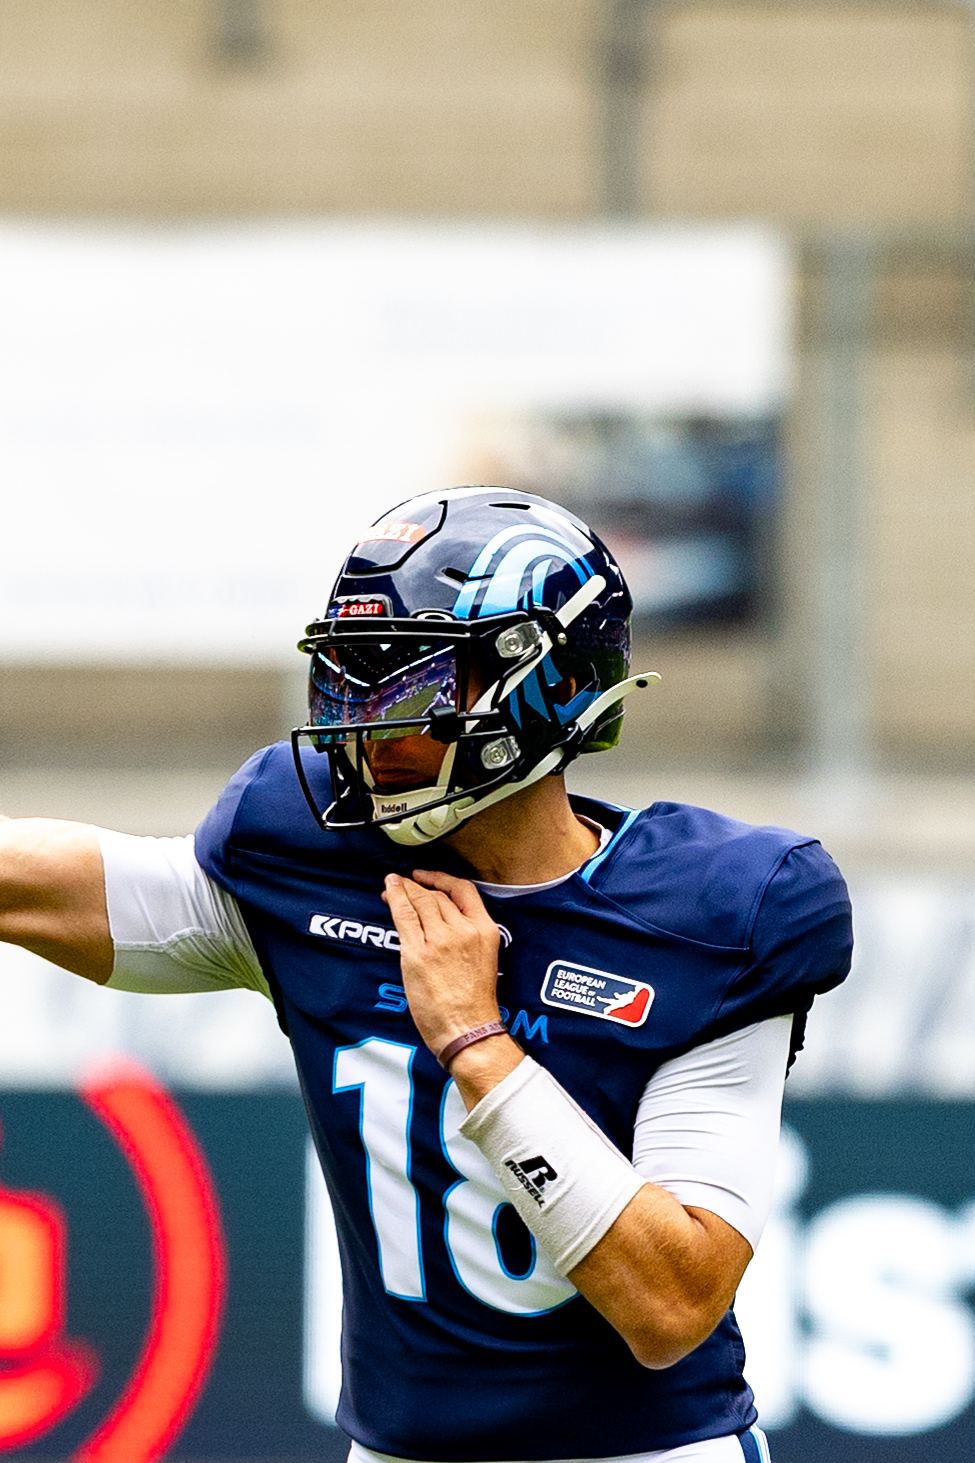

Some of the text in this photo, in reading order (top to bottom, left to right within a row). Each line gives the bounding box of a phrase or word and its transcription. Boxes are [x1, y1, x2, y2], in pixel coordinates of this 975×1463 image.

[349, 604, 380, 616] GAZI
[554, 978, 590, 996] LEAGUE
[556, 969, 607, 990] EUROPEAN
[550, 988, 596, 1007] FOOTBALL
[332, 1036, 581, 1318] 18
[504, 1159, 546, 1209] RUSSELL
